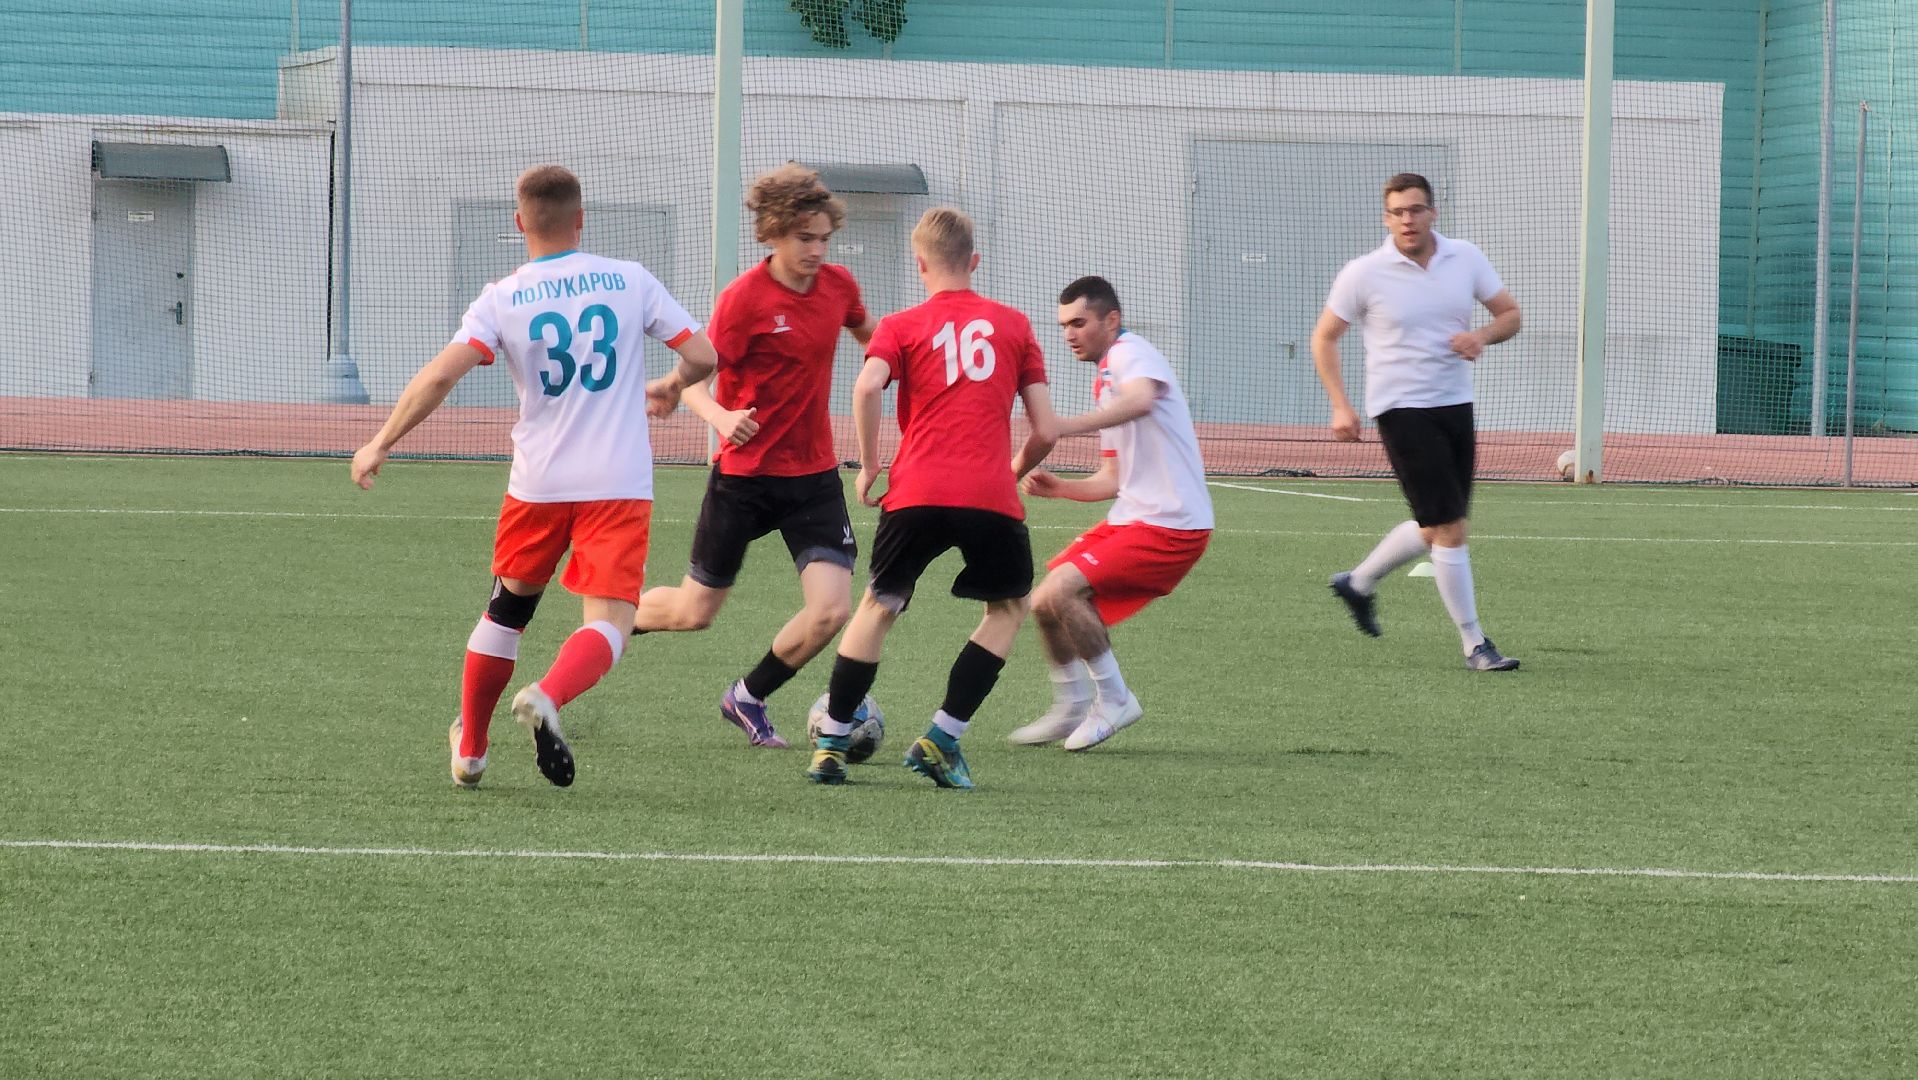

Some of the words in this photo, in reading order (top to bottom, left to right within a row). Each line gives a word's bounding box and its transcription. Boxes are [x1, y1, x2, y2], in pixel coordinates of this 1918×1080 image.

[512, 272, 626, 307] ПОЛУКАРОВ
[529, 304, 619, 397] 33
[932, 318, 996, 387] 16
